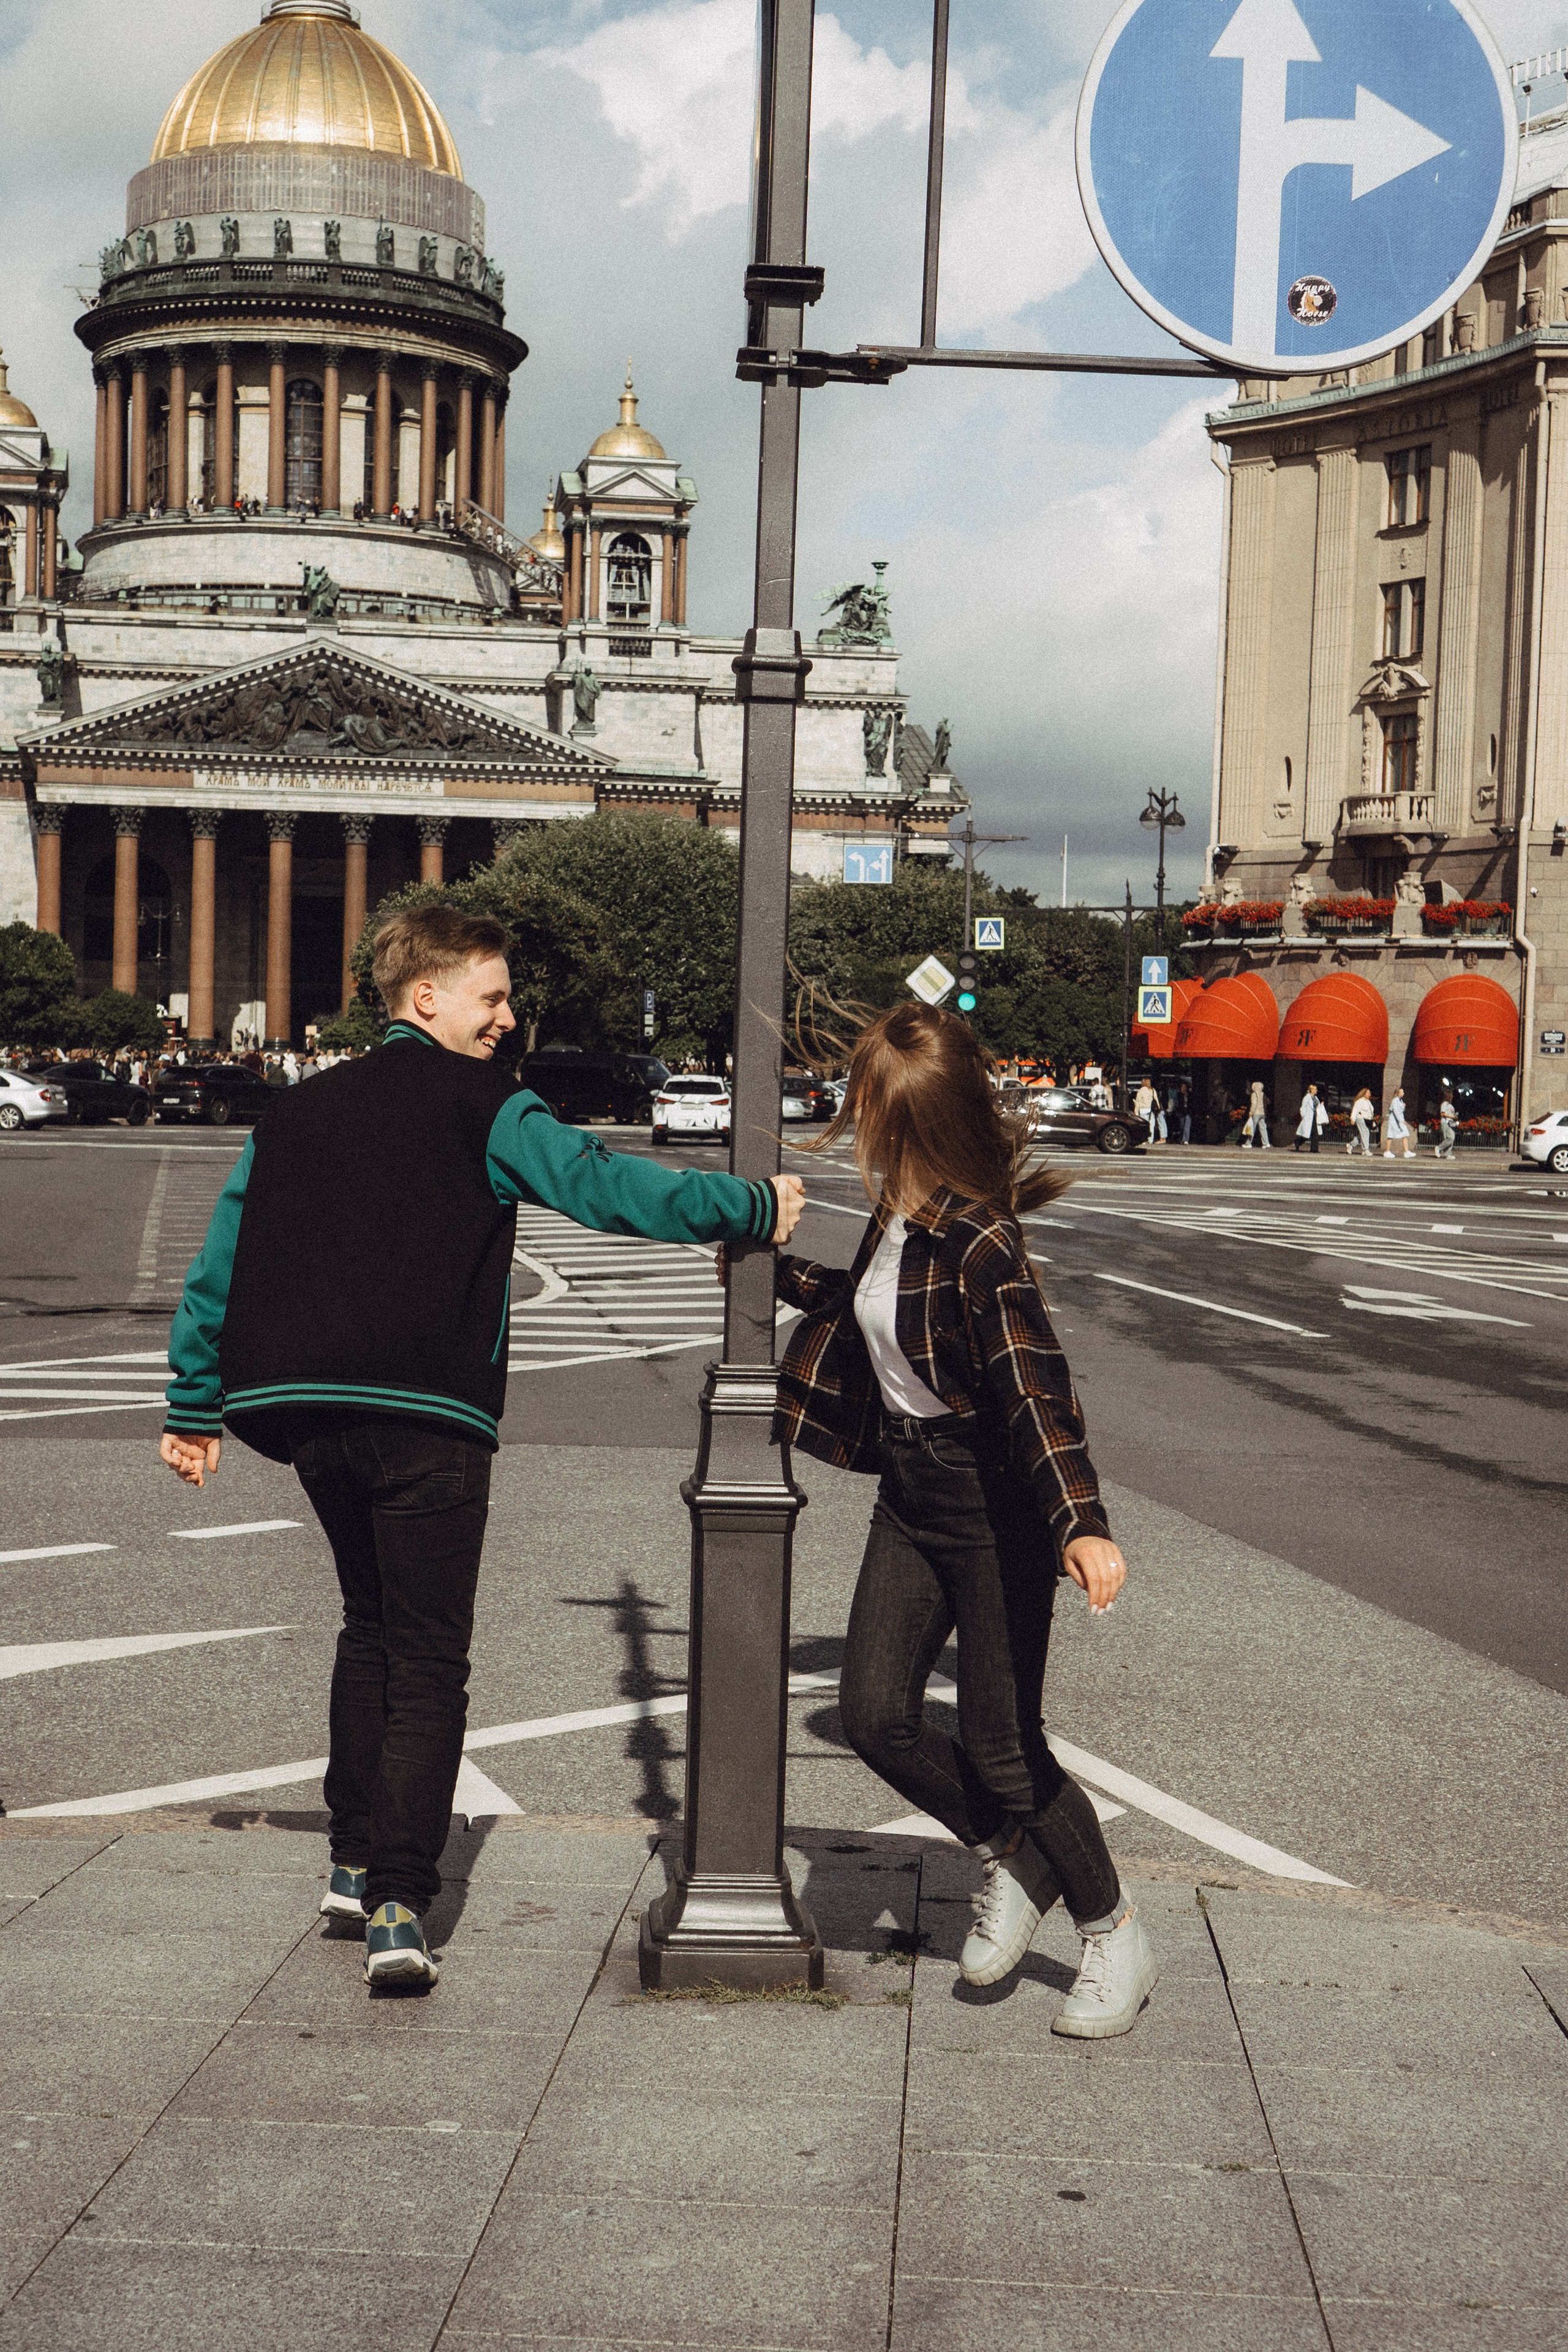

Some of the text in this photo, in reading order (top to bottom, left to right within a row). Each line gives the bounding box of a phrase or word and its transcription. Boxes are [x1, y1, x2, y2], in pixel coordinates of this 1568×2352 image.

[1294, 282, 1330, 295] Happy
[1296, 307, 1329, 318] Horse
[1357, 404, 1448, 443] ASTORIA
